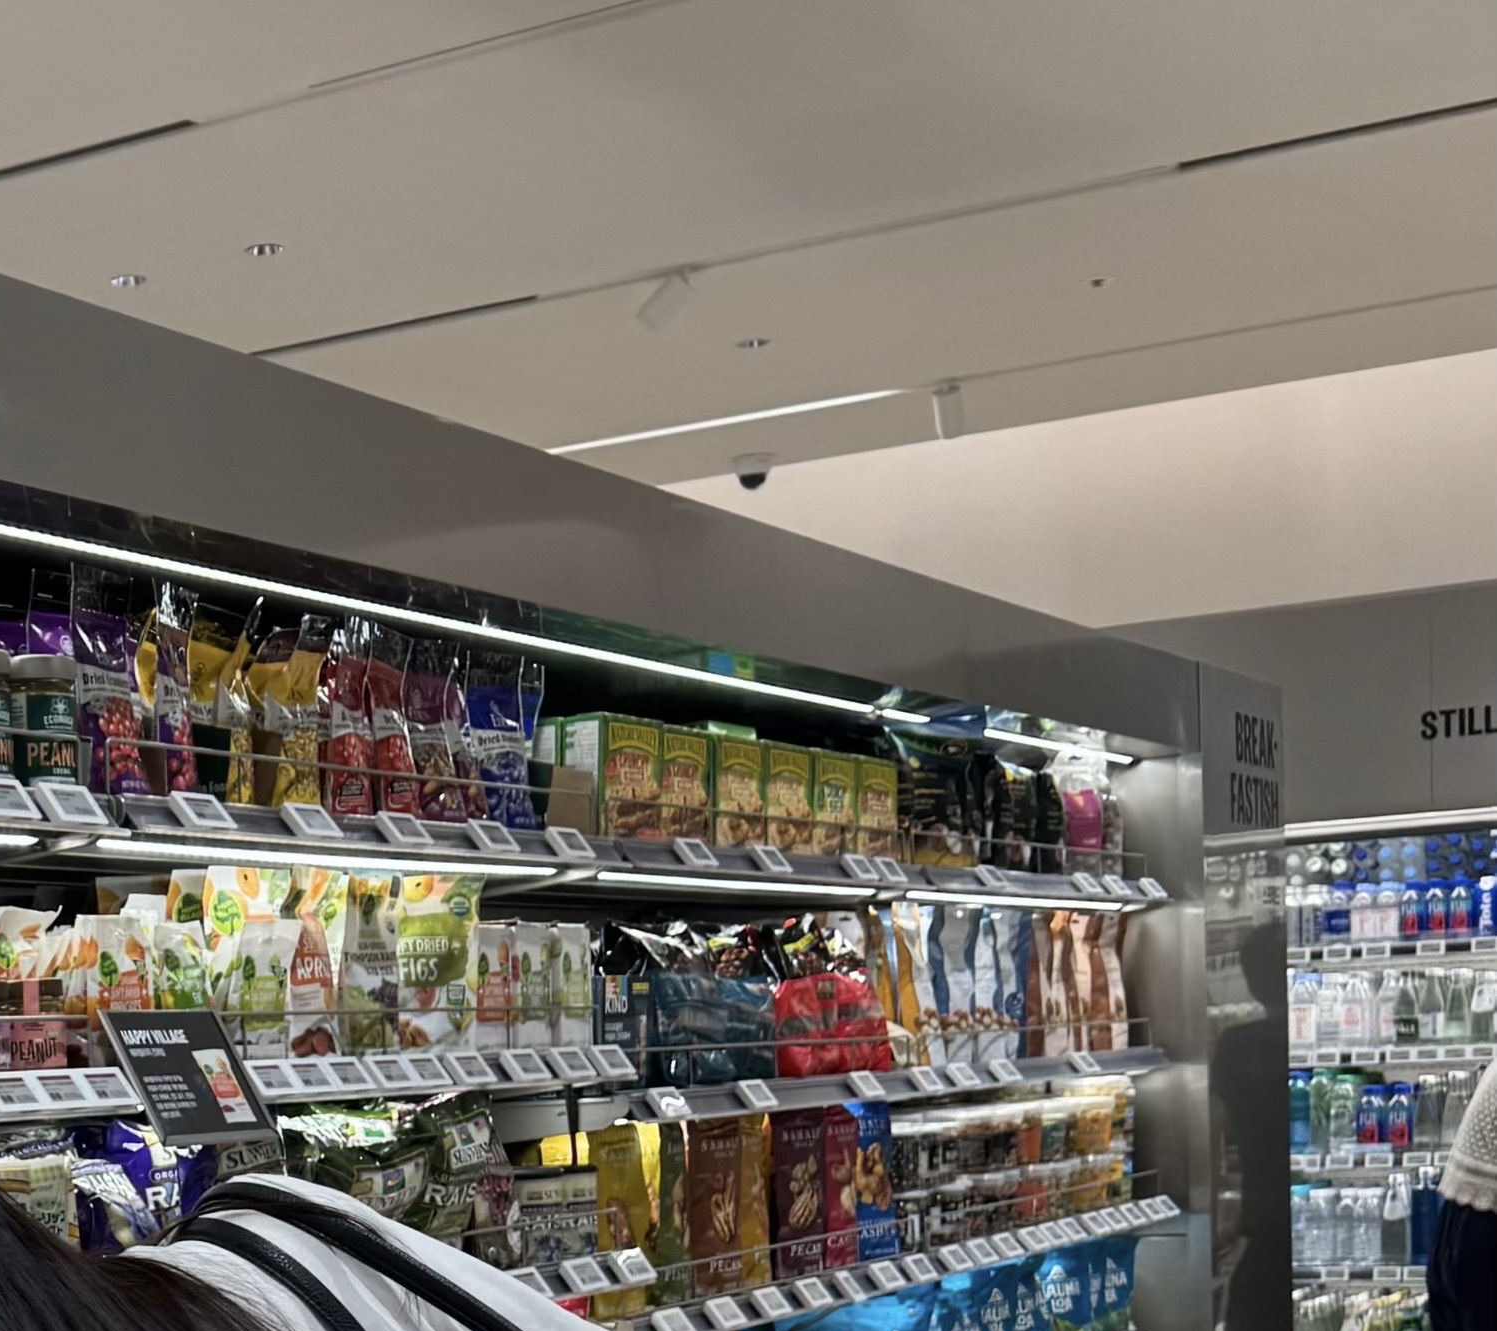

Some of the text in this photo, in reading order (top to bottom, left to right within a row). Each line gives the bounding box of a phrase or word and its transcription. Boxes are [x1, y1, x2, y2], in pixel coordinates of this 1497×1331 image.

[1420, 705, 1497, 741] STILL
[1230, 772, 1280, 829] FASTISH
[399, 954, 439, 982] FIGS
[605, 997, 628, 1014] KIND
[10, 1036, 58, 1061] PEANUT
[119, 1029, 189, 1045] HAPPY VILLAGE
